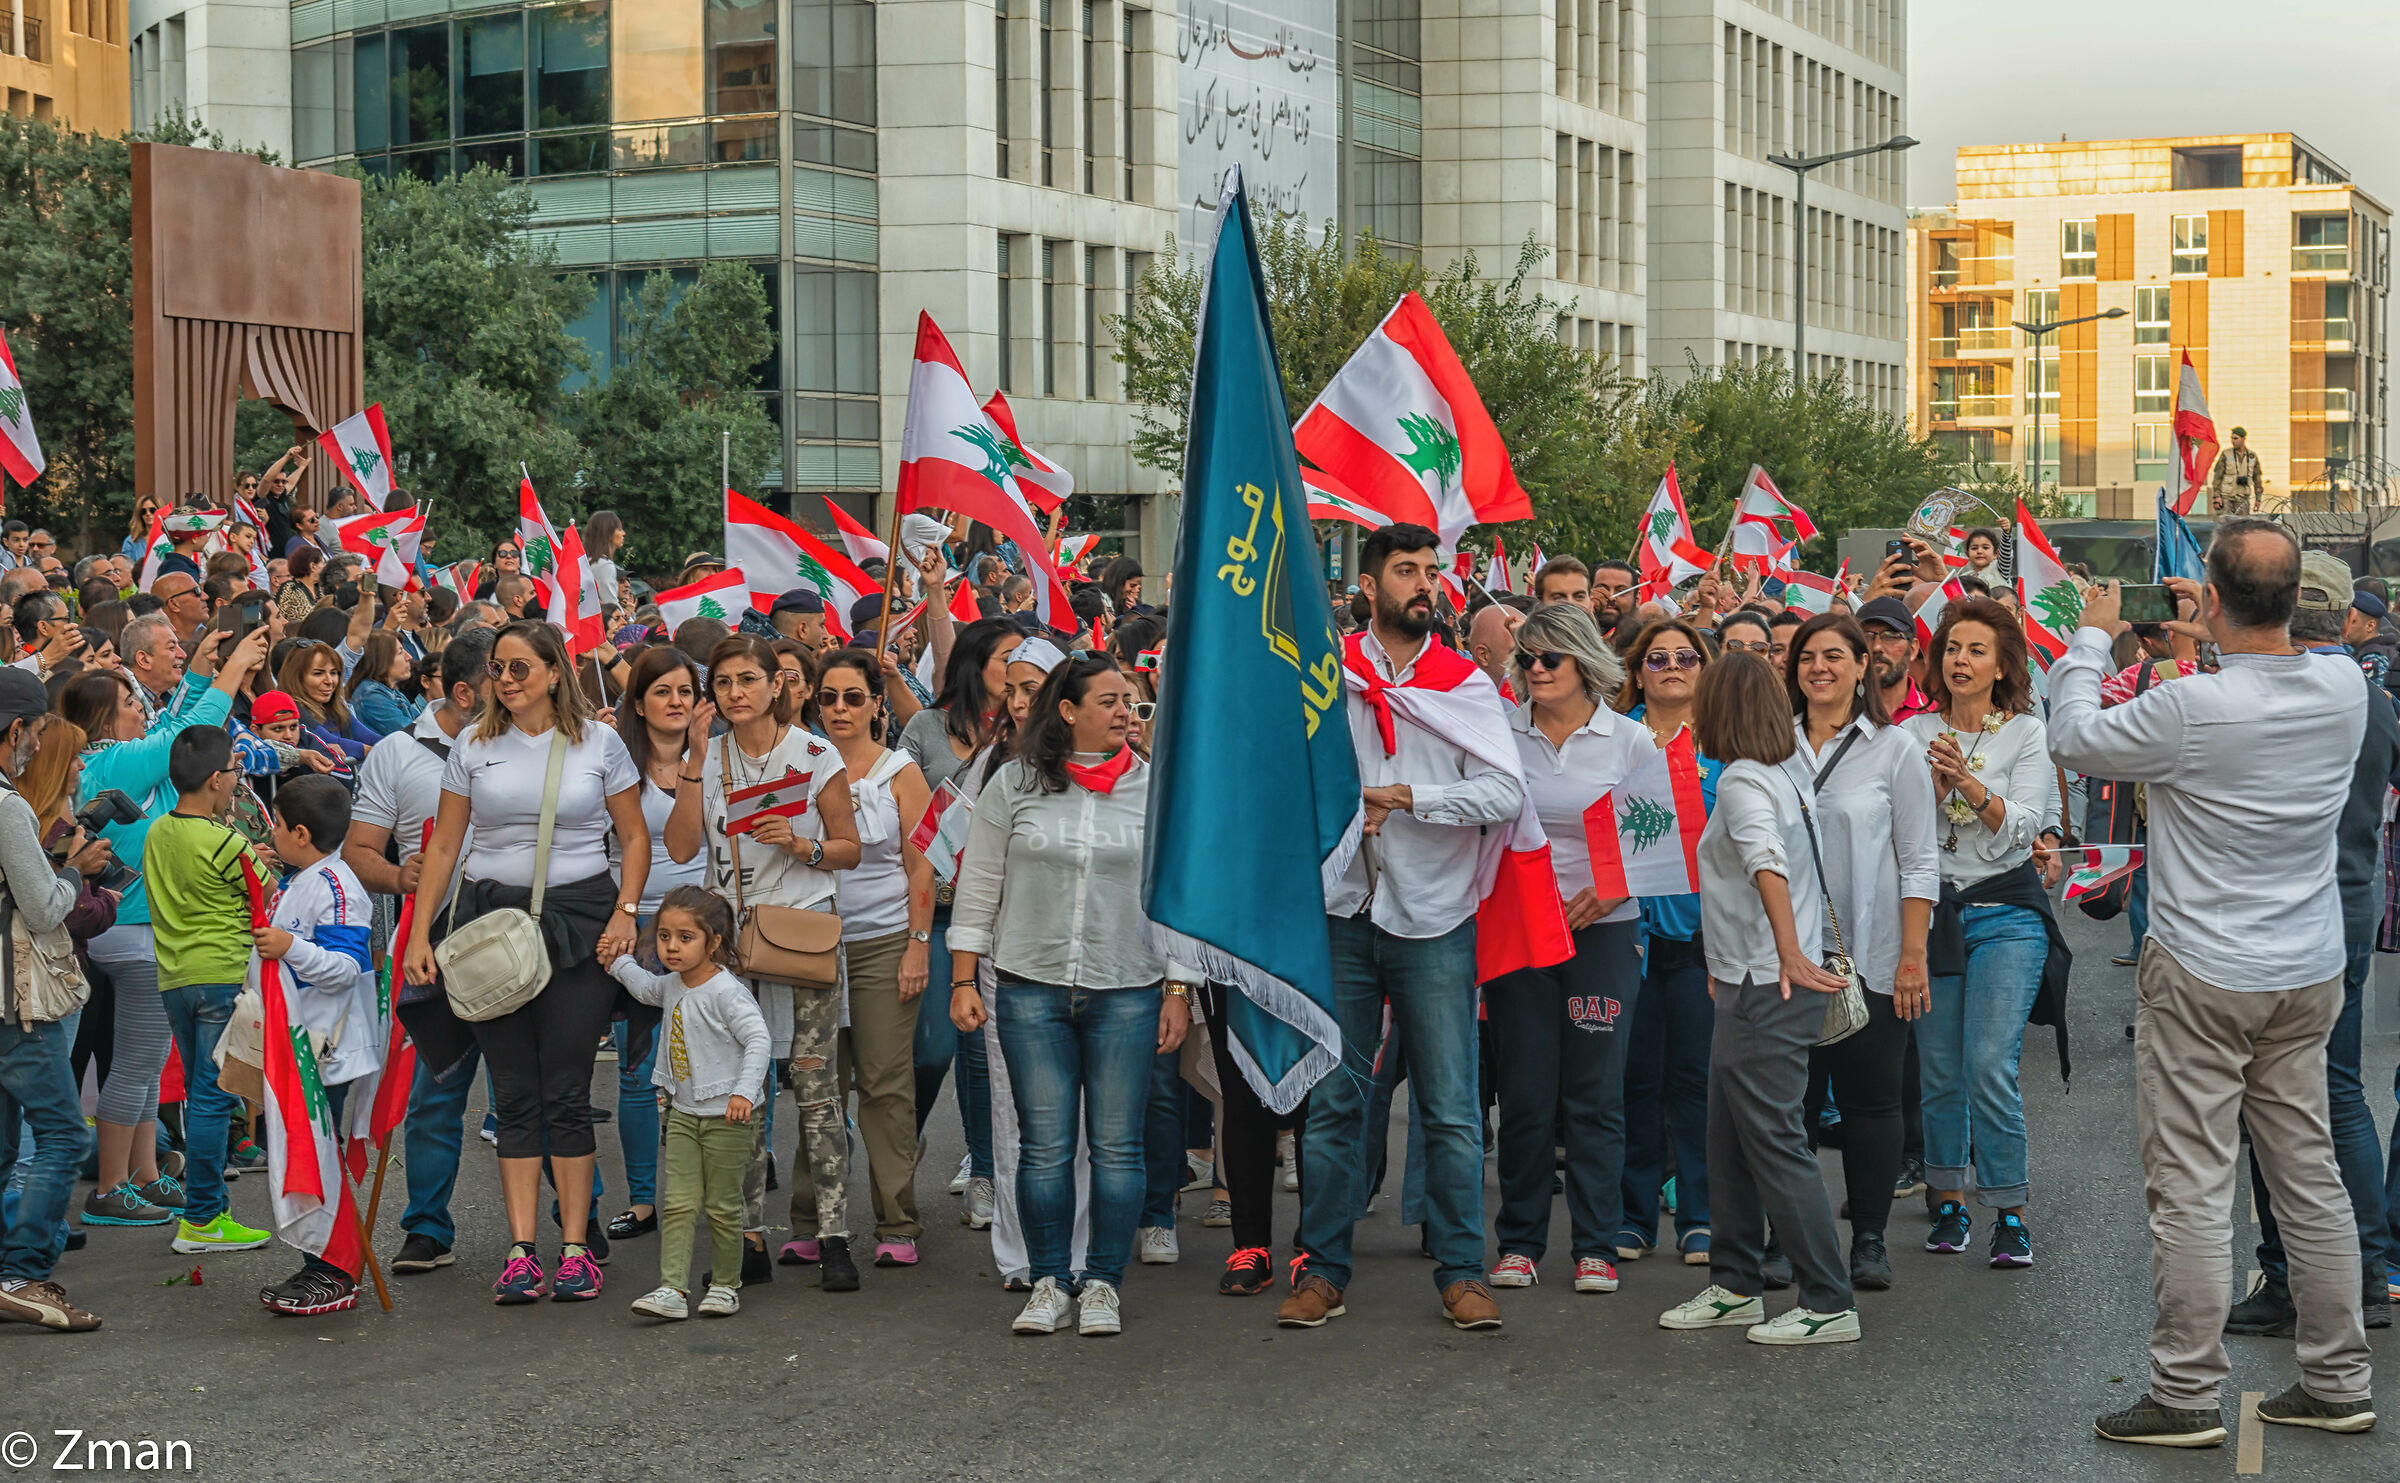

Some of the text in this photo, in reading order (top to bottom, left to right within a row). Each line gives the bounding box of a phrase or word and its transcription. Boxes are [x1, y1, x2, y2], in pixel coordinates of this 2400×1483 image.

[1178, 0, 1217, 70] والرجال
[1220, 3, 1286, 60] للنساء
[1216, 89, 1250, 151] سبيل
[1250, 86, 1260, 149] في
[1217, 482, 1265, 597] فوج
[1027, 817, 1140, 851] المأة
[1567, 995, 1622, 1025] GAP
